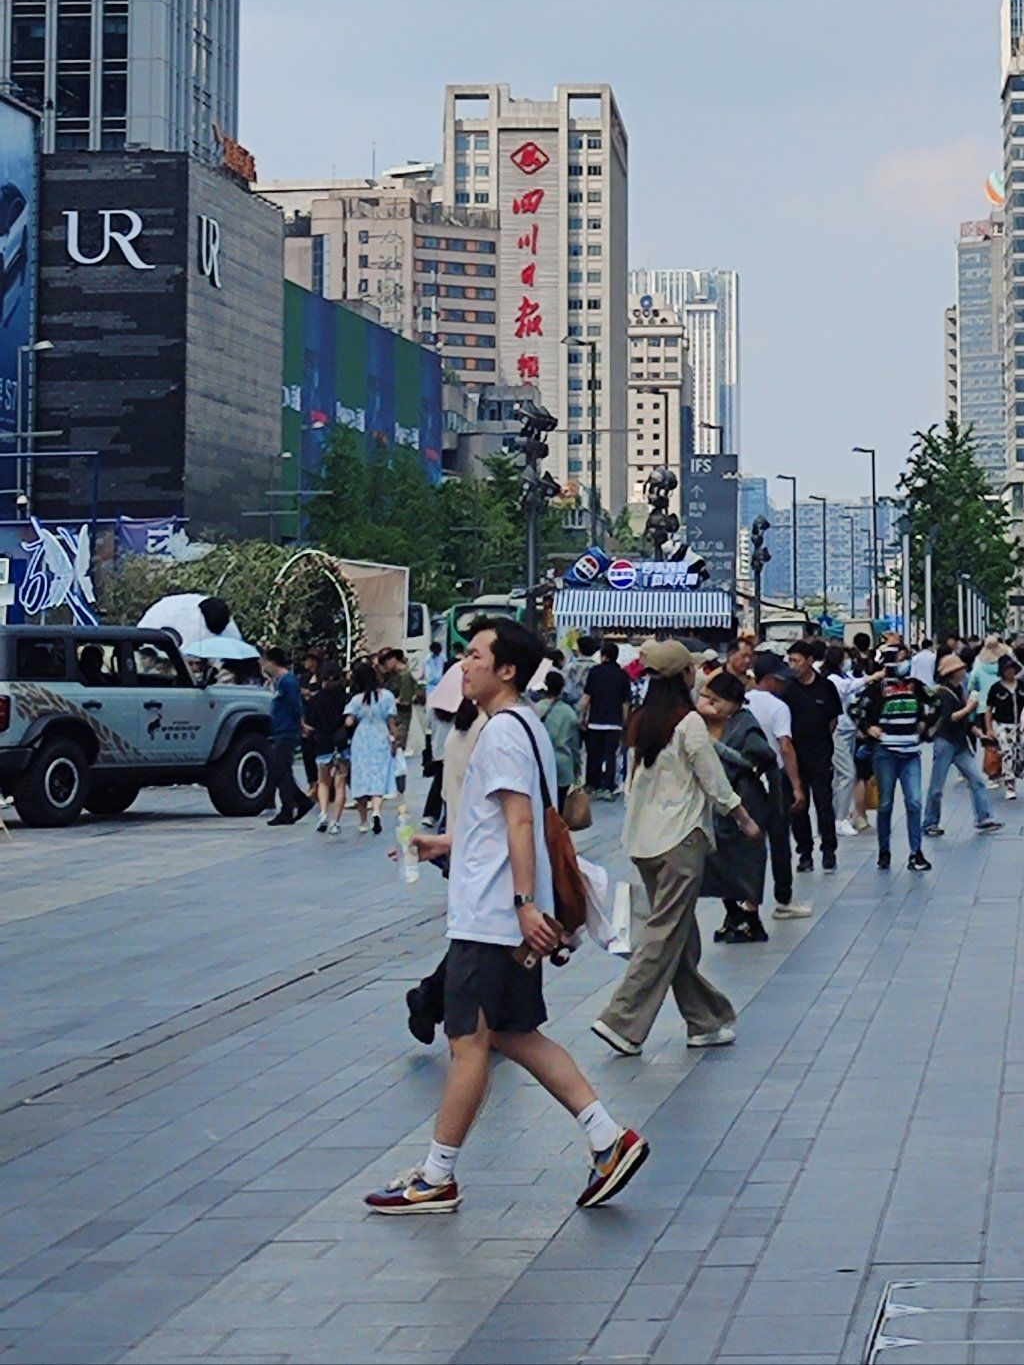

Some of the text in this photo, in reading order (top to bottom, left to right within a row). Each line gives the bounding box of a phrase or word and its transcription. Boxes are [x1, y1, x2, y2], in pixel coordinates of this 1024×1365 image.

[61, 209, 157, 269] UR
[200, 215, 222, 289] UR
[690, 458, 712, 473] IFS
